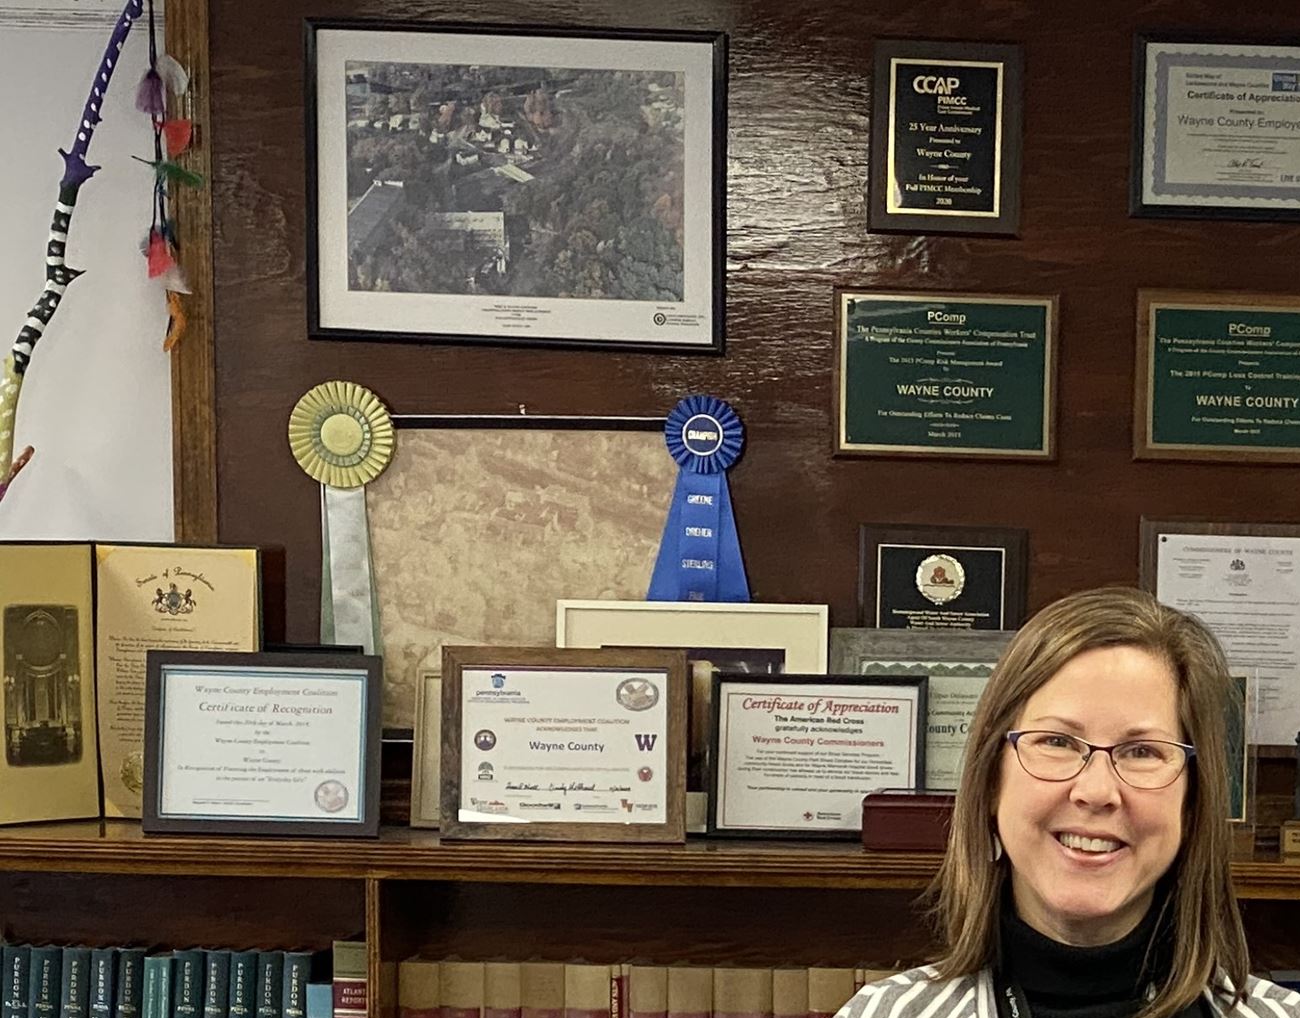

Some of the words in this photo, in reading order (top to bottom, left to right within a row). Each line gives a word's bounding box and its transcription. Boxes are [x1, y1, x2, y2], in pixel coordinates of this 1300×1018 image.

[913, 76, 960, 94] CCAP
[937, 96, 967, 105] PIMCC
[1187, 91, 1234, 101] Certificate
[1237, 92, 1246, 101] of
[1178, 115, 1214, 126] Wayne
[1217, 117, 1253, 129] County
[909, 123, 918, 131] 25
[920, 123, 937, 132] Year
[938, 124, 982, 135] Anniversary
[916, 149, 942, 159] Wayne
[944, 150, 971, 160] County
[928, 174, 946, 182] Honor
[944, 186, 982, 195] Membership
[928, 312, 966, 323] PComp
[871, 327, 912, 335] Pennsylvania
[973, 329, 1017, 339] Compensation
[1020, 331, 1036, 339] Trust
[1229, 323, 1271, 335] PComp
[1202, 371, 1227, 379] PComp
[1248, 372, 1274, 380] Control
[897, 385, 939, 396] WAYNE
[943, 386, 994, 397] COUNTY
[1196, 395, 1241, 406] WAYNE
[1246, 397, 1299, 408] COUNTY
[195, 685, 222, 694] Wayne
[224, 687, 251, 695] County
[253, 688, 300, 696] Employment
[302, 688, 338, 696] Coalition
[476, 689, 521, 697] pennsylvania
[199, 702, 254, 713] Certificate
[257, 704, 268, 713] of
[272, 704, 333, 715] Recognition
[742, 697, 804, 712] Certificate
[807, 698, 820, 714] of
[824, 699, 899, 716] Appreciation
[790, 716, 824, 724] American
[776, 726, 808, 734] gratefully
[810, 726, 863, 734] acknowledges
[927, 725, 956, 736] ounty
[529, 741, 565, 752] Wayne
[568, 743, 605, 752] County
[635, 734, 657, 751] W
[752, 736, 782, 745] Wayne
[784, 736, 816, 746] County
[817, 738, 884, 748] Commissioners
[13, 957, 21, 998] PURDON
